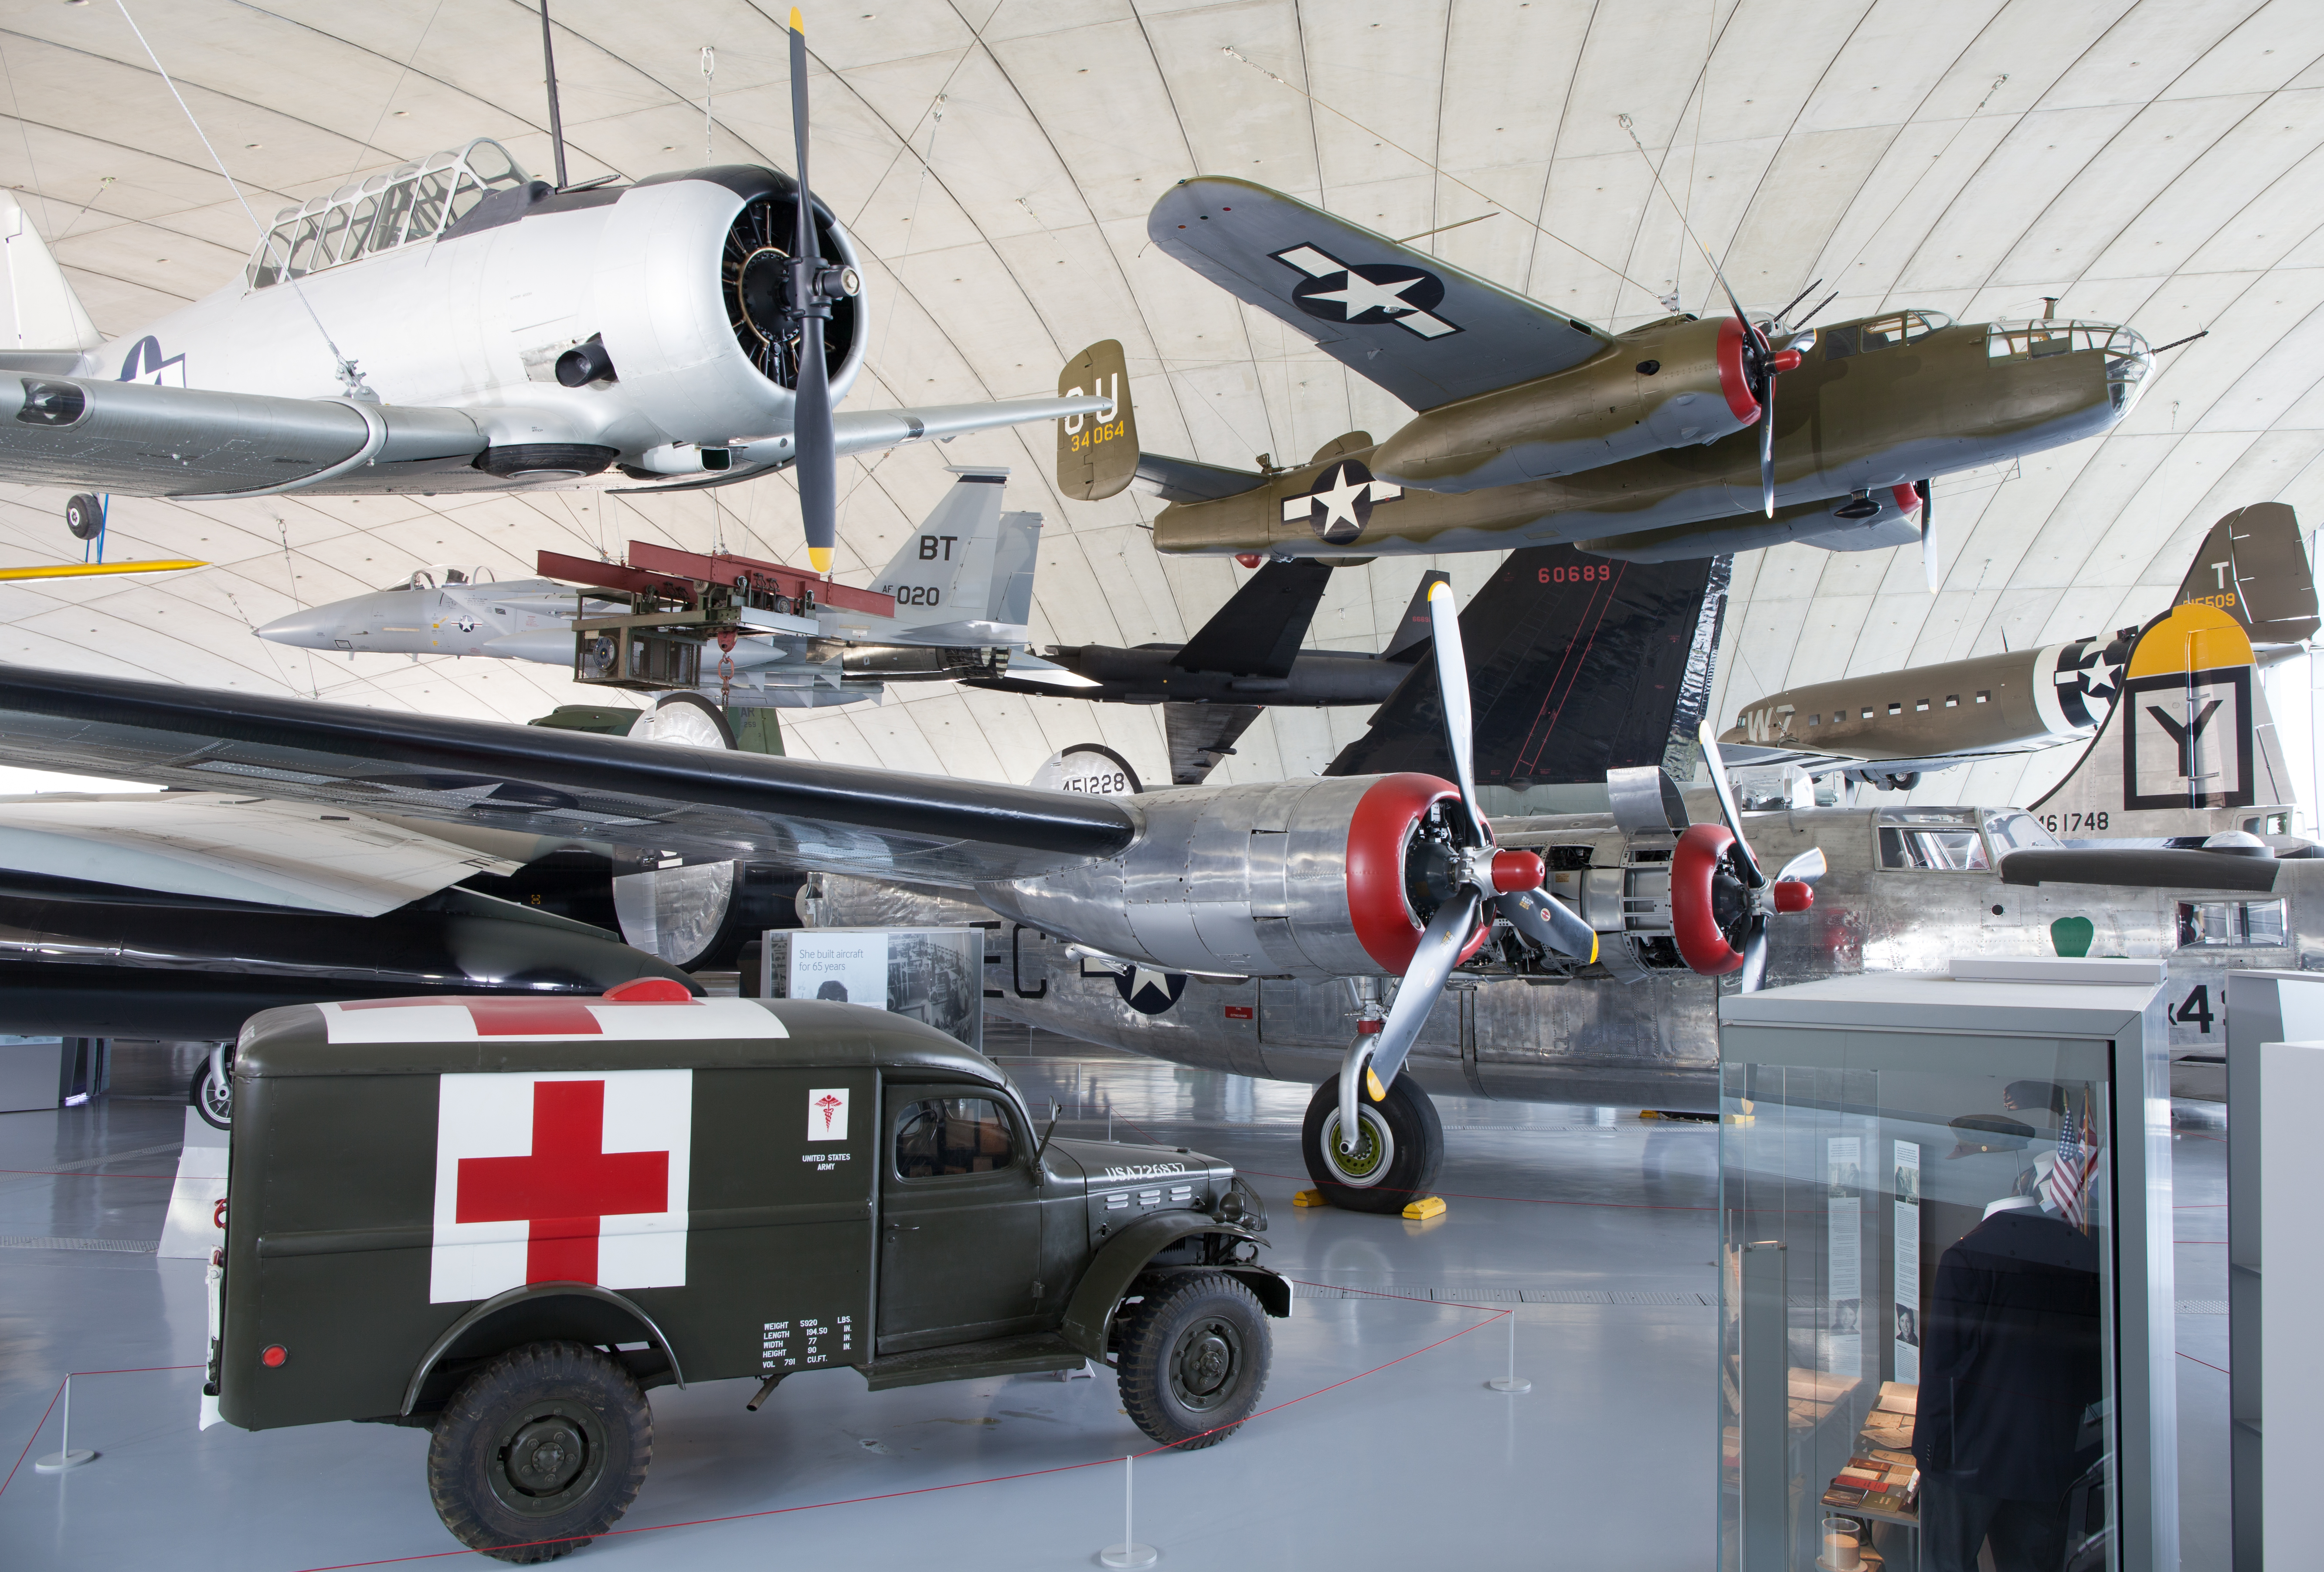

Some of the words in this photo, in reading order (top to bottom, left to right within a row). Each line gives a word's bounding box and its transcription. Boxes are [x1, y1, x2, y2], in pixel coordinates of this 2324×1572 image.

[1071, 420, 1125, 452] 34064
[919, 535, 958, 561] BT
[1538, 565, 1610, 583] 60689
[2212, 561, 2229, 589] T
[897, 586, 940, 606] 020
[741, 707, 755, 717] AR
[2145, 699, 2223, 778] Y
[799, 949, 814, 959] She
[817, 948, 834, 959] built
[836, 948, 864, 959] aircraft
[799, 961, 810, 971] for
[812, 962, 822, 971] 65
[824, 963, 846, 973] years
[1104, 1162, 1186, 1182] USA726837
[764, 1321, 789, 1330] WEIGHT
[764, 1330, 790, 1339] LENGTH
[806, 1327, 828, 1335] 194.50
[763, 1340, 783, 1349] WIDTH
[763, 1349, 787, 1358] HEIGHT
[762, 1360, 775, 1368] VOL
[784, 1358, 795, 1366] 791
[807, 1355, 828, 1363] CU.FT.
